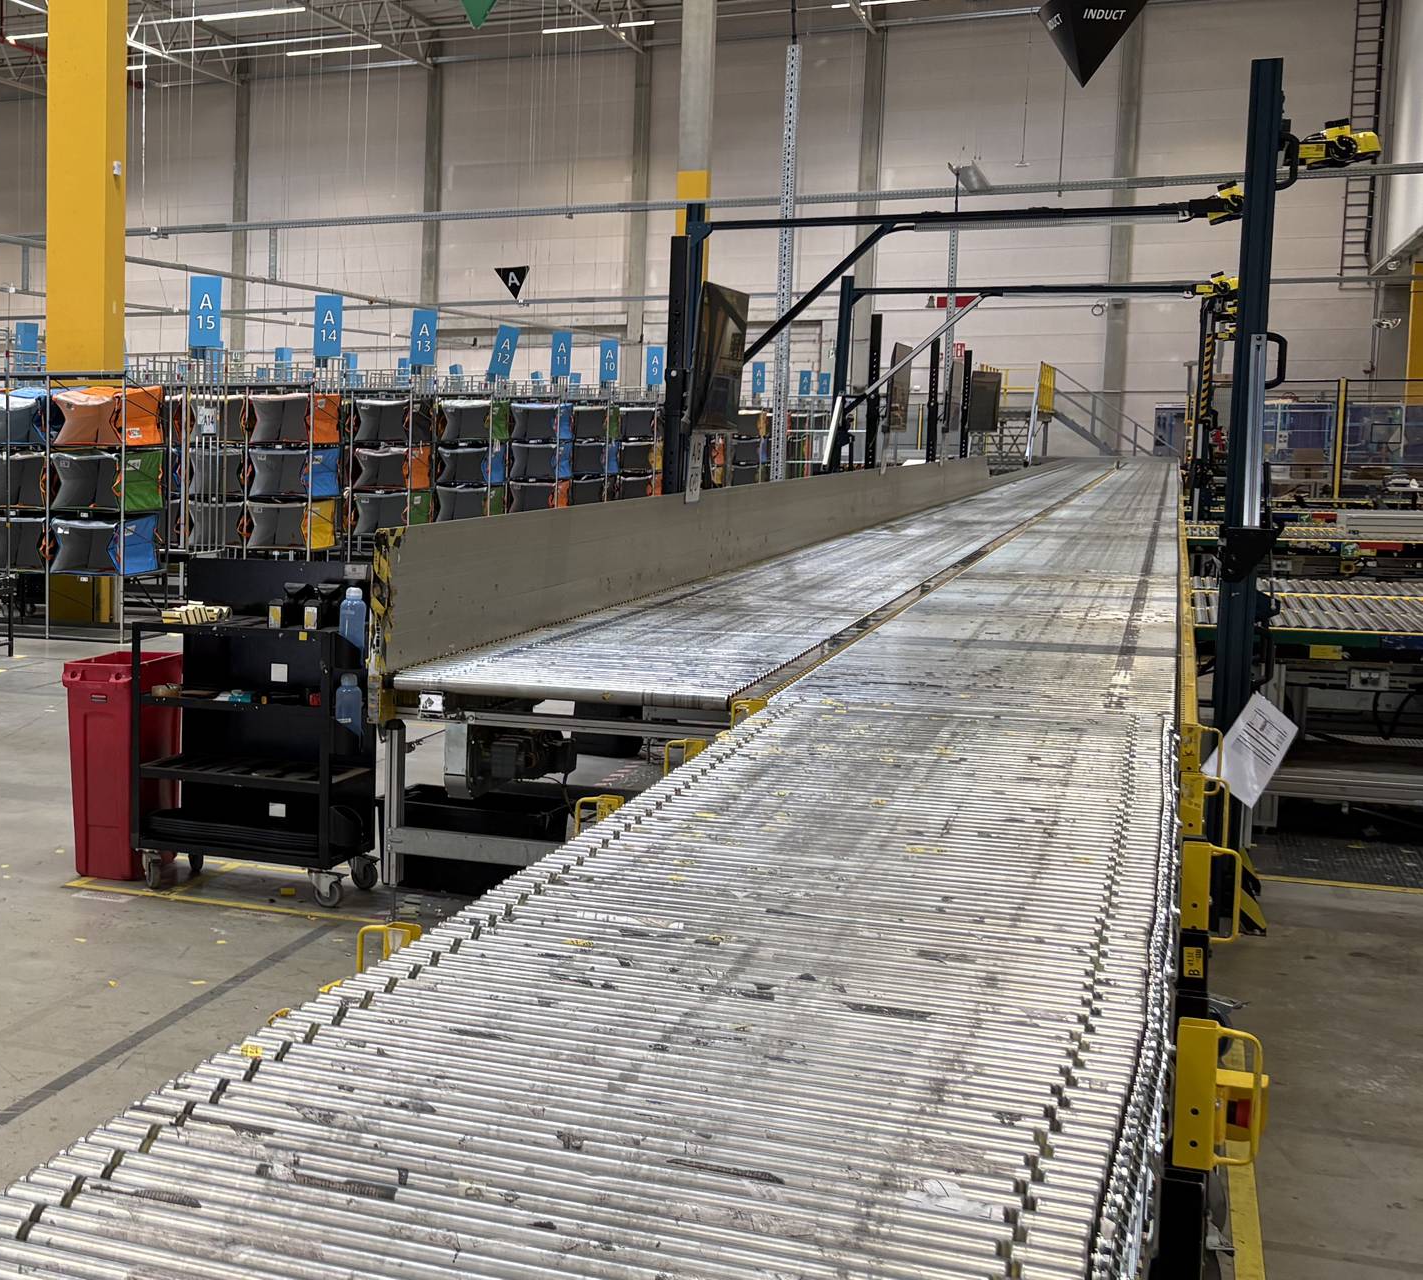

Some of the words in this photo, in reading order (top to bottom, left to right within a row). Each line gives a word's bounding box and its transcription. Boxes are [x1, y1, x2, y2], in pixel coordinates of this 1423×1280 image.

[1083, 8, 1127, 20] INDUCT
[507, 271, 521, 287] A
[199, 293, 213, 310] A
[196, 315, 216, 330] 15
[323, 310, 335, 325] A
[320, 329, 337, 342] 14
[419, 323, 430, 337] A
[416, 340, 431, 352] 13
[500, 338, 511, 351] A
[557, 342, 566, 353] A
[496, 352, 510, 365] 12
[555, 355, 567, 366] 11
[605, 349, 614, 360] A
[651, 355, 659, 365] A
[604, 361, 616, 371] 10
[652, 367, 658, 376] 9
